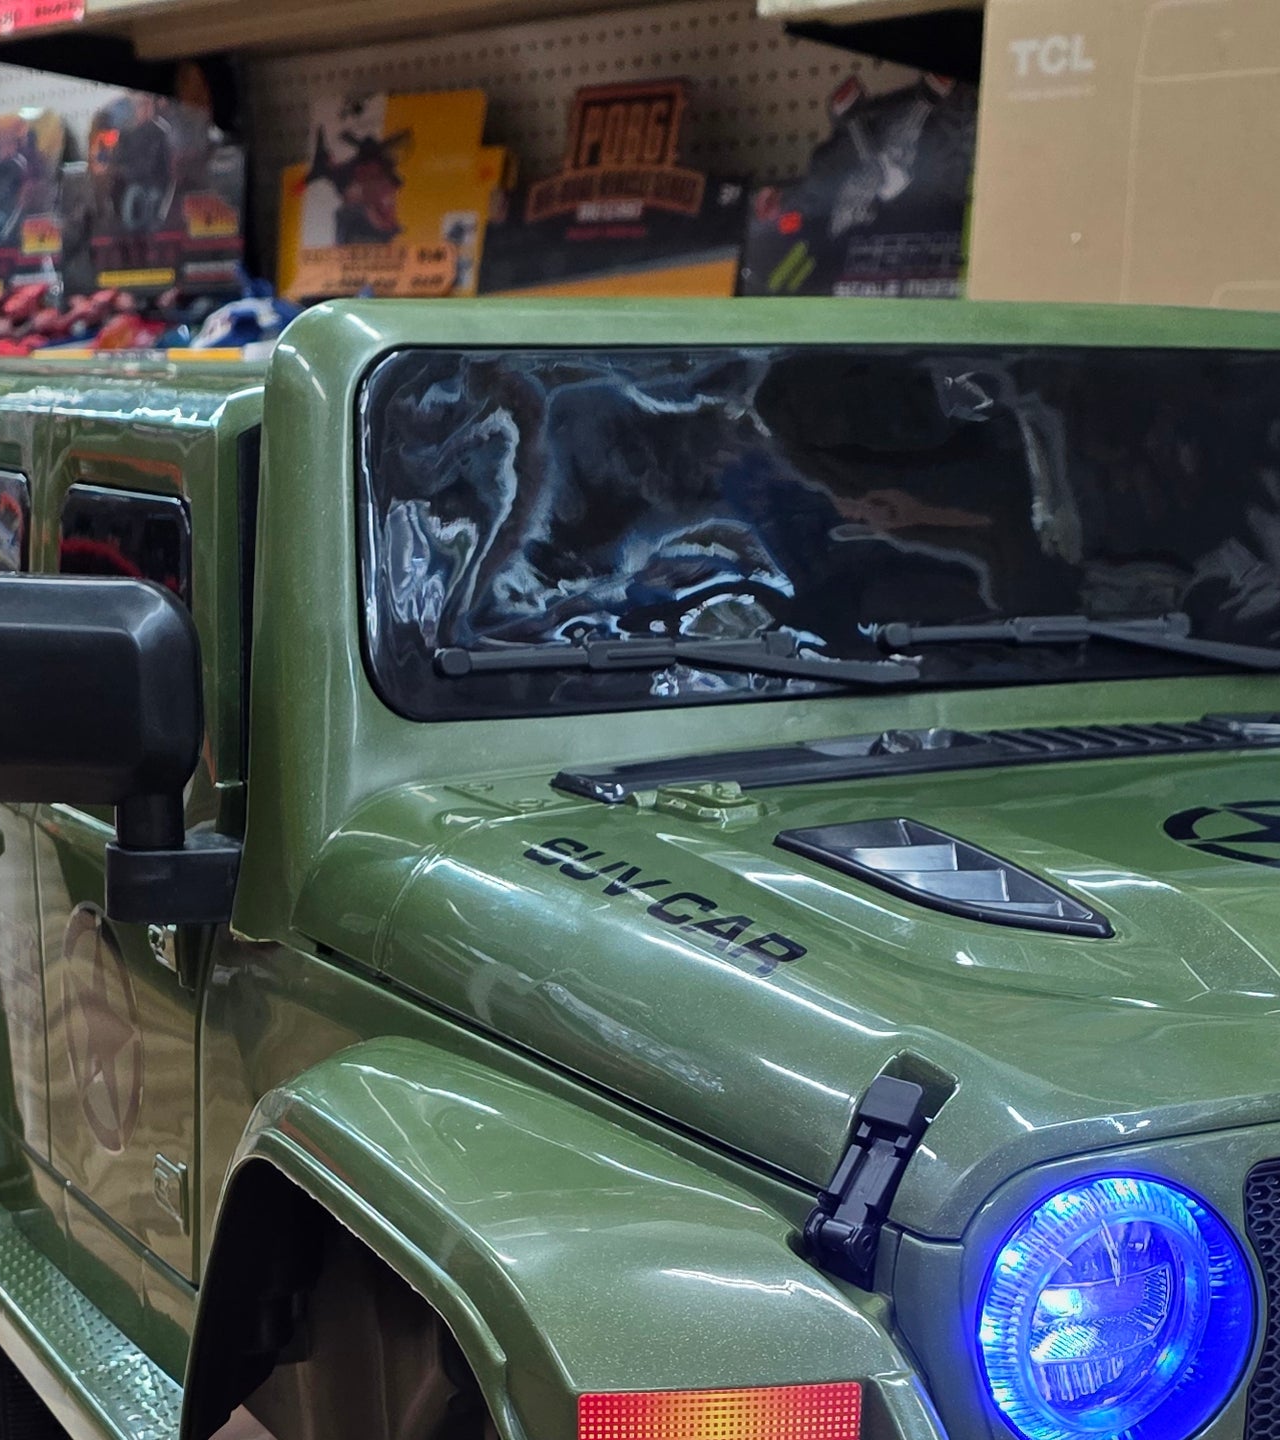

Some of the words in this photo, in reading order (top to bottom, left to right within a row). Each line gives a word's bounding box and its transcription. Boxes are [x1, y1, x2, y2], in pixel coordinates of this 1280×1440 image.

[1009, 34, 1096, 78] TCL
[522, 836, 673, 899] SUV
[646, 891, 809, 979] CAR
